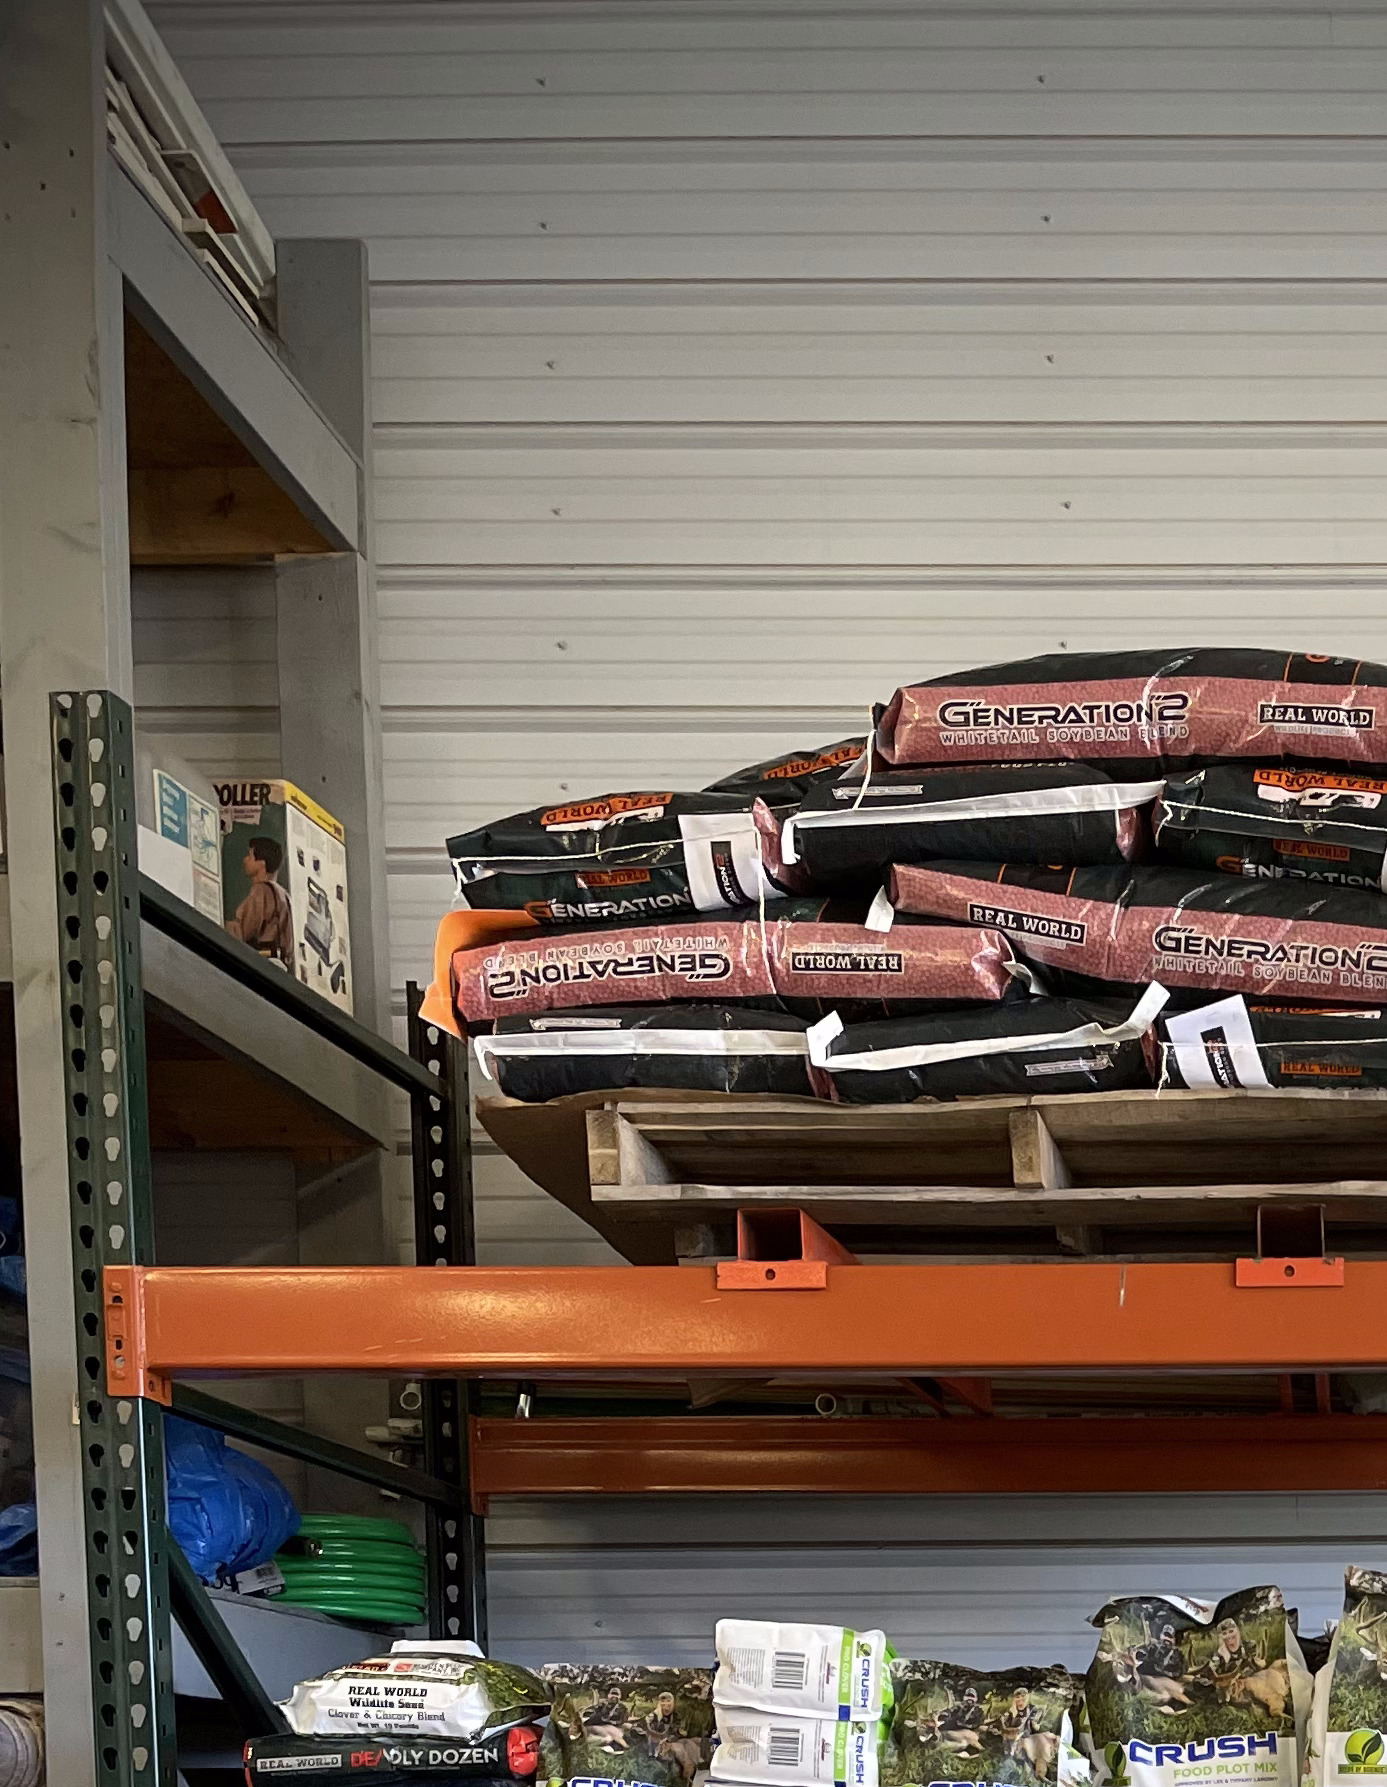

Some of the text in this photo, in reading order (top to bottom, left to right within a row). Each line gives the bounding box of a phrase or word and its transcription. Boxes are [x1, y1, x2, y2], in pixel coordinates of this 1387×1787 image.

[938, 693, 1190, 728] GENERATION2
[1262, 706, 1371, 725] REAL WORLD
[941, 728, 1039, 746] WHITETAIL
[1048, 726, 1129, 742] SOYBEAN
[1258, 771, 1386, 791] REAL WORLD
[972, 907, 1017, 928] REAL
[1022, 917, 1083, 940] WORLD
[546, 942, 626, 961] SOYBEAN
[794, 954, 899, 970] REAL WORLD
[488, 952, 732, 999] GENERATION2
[1154, 957, 1245, 976] WHITETAIL
[1253, 966, 1332, 984] SOYBEAN
[348, 1685, 428, 1697] REAL WORLD
[860, 1658, 871, 1709] CRUSH
[363, 1710, 372, 1720] &
[259, 1758, 293, 1770] REAL
[297, 1756, 340, 1769] WORLD
[428, 1748, 499, 1766] DOZEN
[855, 1735, 865, 1784] CRUSH
[1129, 1732, 1278, 1766] CRUSH
[1173, 1762, 1278, 1779] FOOD PLOT MIX
